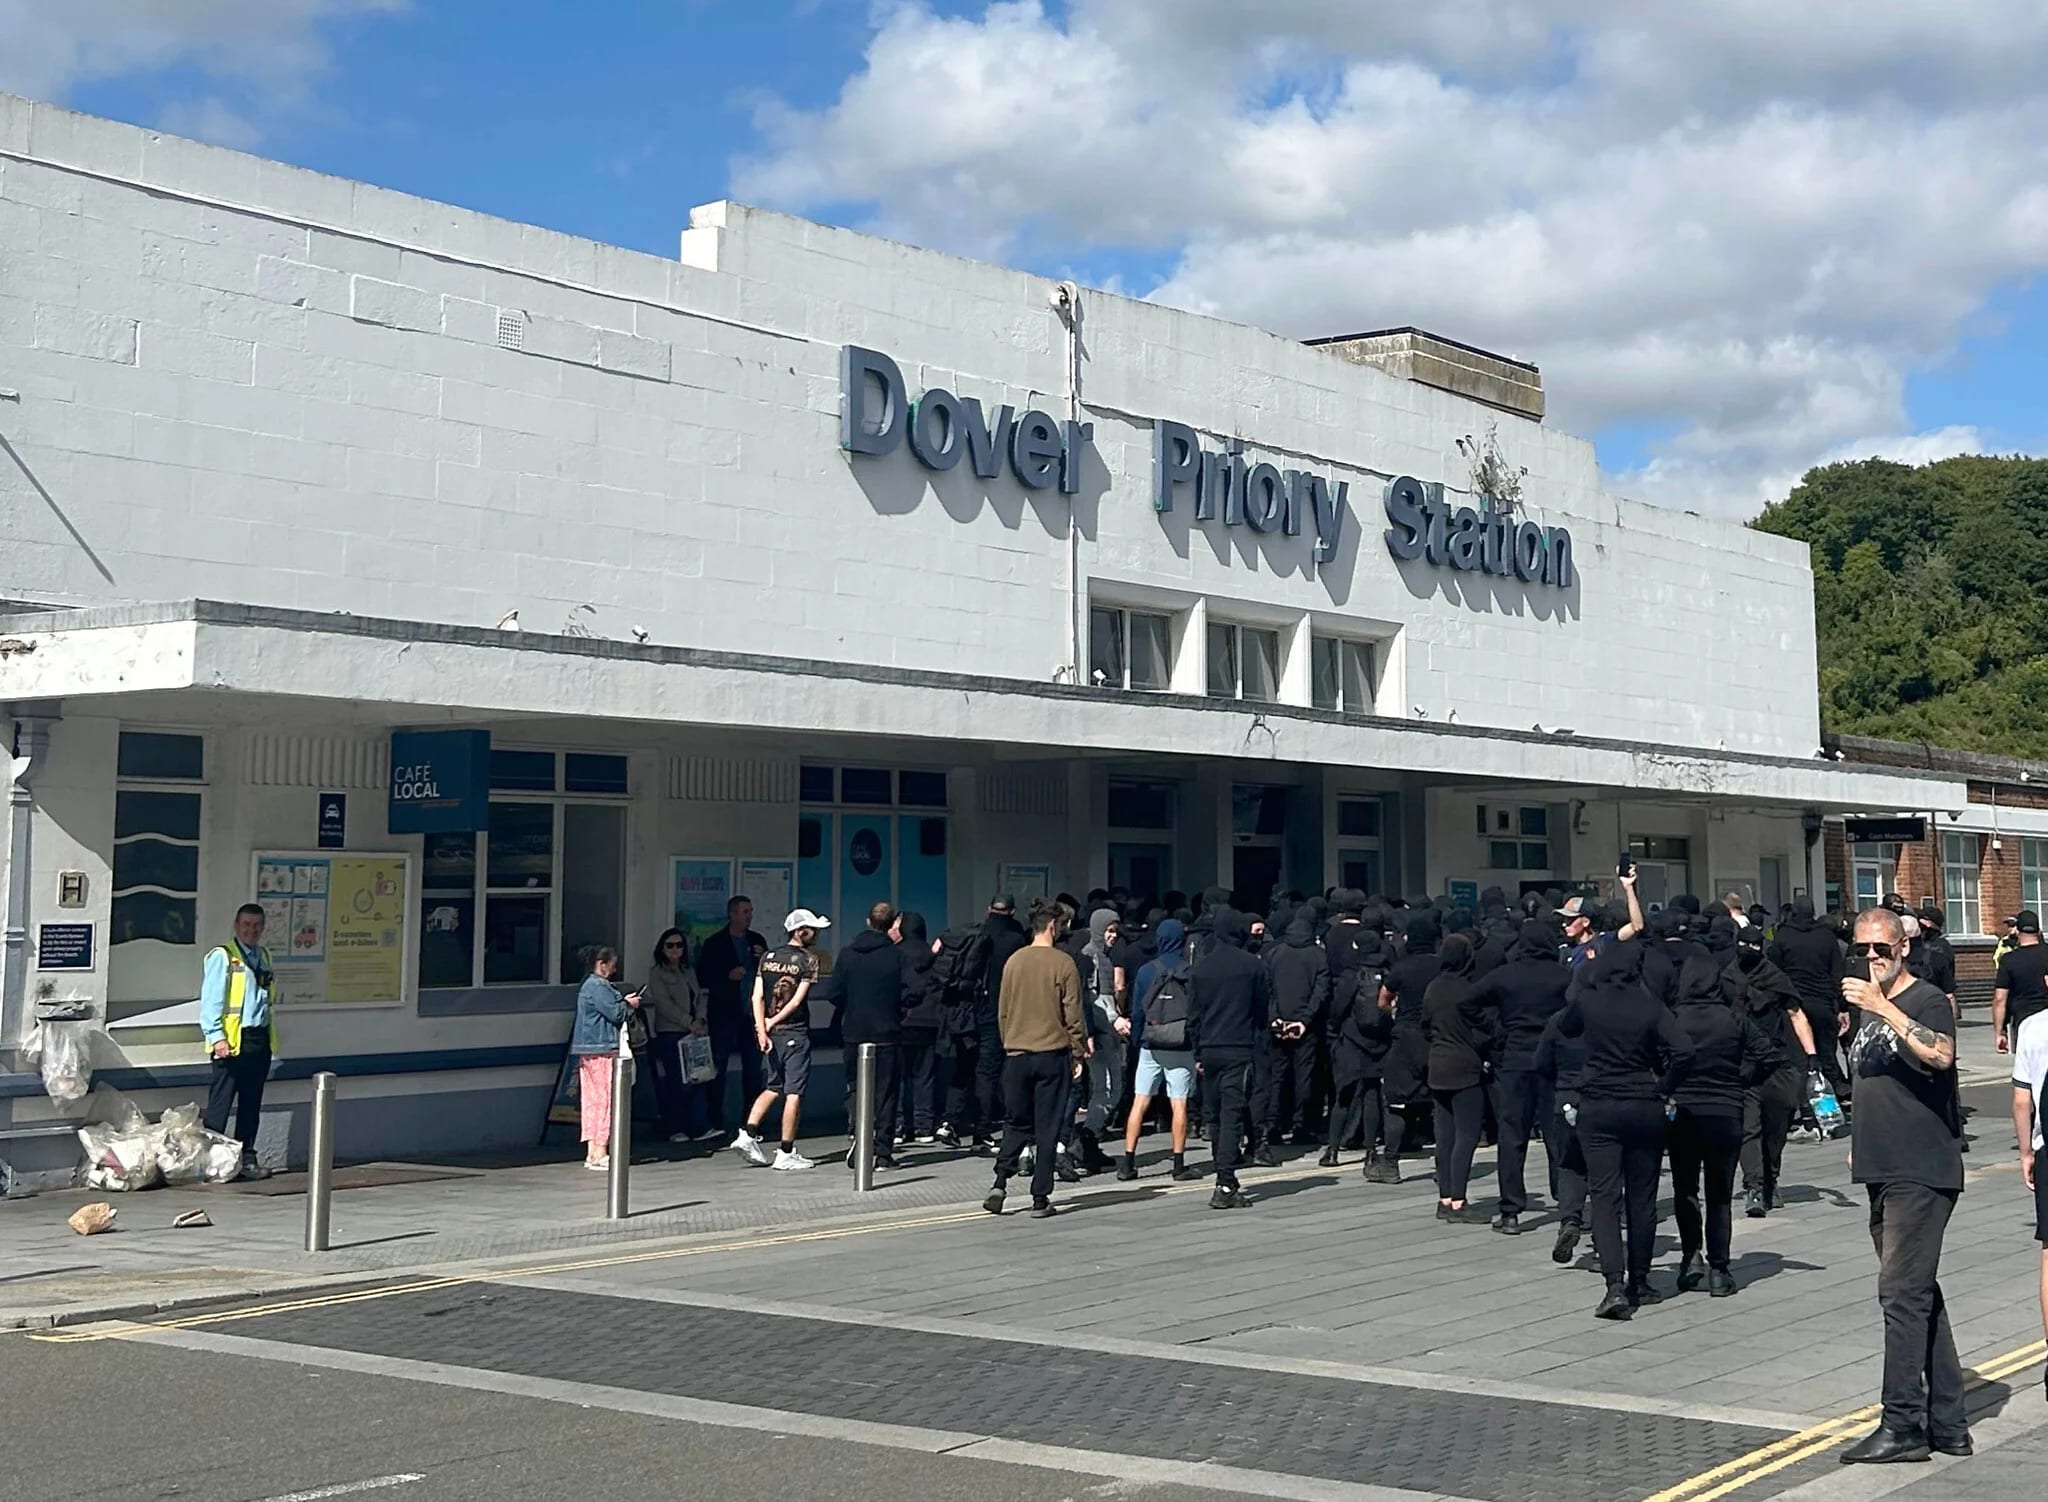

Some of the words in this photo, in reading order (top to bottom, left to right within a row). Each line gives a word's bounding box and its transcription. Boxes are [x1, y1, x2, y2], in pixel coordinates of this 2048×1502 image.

[842, 345, 1092, 494] Dover
[1154, 419, 1348, 563] Priory
[1385, 475, 1572, 588] Station
[394, 761, 431, 782] CAFÉ
[394, 782, 440, 799] LOCAL
